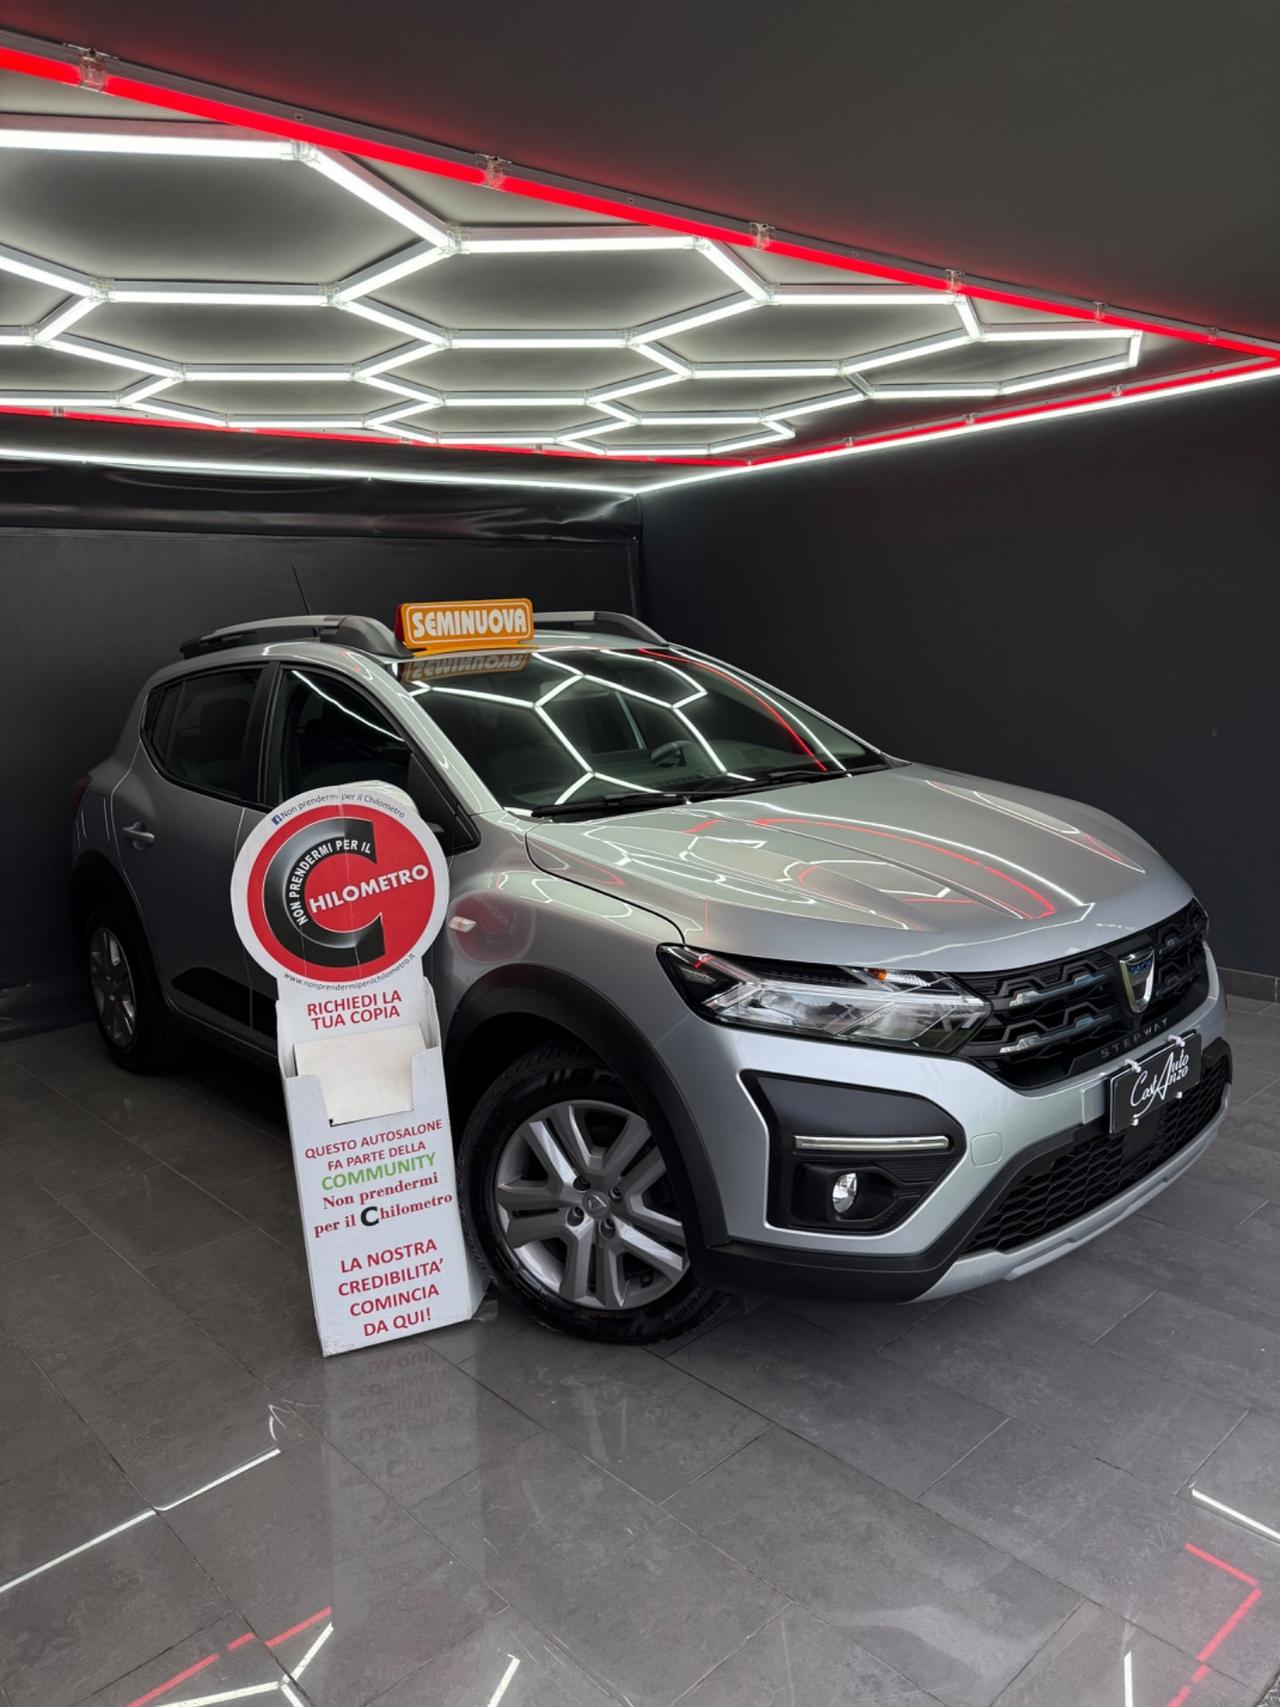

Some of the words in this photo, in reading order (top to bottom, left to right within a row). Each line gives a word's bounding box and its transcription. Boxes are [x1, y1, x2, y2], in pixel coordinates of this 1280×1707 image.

[412, 608, 527, 638] SEMINUOVA
[281, 806, 298, 819] Non
[341, 793, 356, 801] per
[364, 794, 405, 818] Chilometro
[335, 839, 358, 851] PER
[361, 841, 371, 854] IL
[289, 842, 333, 898] PRENDERMI
[289, 901, 309, 926] NON
[307, 993, 377, 1017] RICHIEDI
[382, 990, 402, 1004] LA
[311, 1014, 346, 1031] TUA
[350, 1005, 400, 1024] COPIA
[1101, 1017, 1169, 1058] STEPWAY
[305, 1139, 357, 1159] QUESTO
[360, 1119, 443, 1148] AUTOSALONE
[321, 1151, 436, 1191] COMMUNITY
[327, 1160, 343, 1171] FA
[346, 1149, 385, 1168] PARTE
[389, 1141, 426, 1158] DELLA
[322, 1194, 355, 1210] Non
[359, 1171, 439, 1205] prendermi
[314, 1220, 341, 1239] per
[345, 1213, 356, 1228] il
[340, 1257, 362, 1273] LA
[367, 1238, 438, 1267] NOSTRA
[338, 1257, 444, 1297] CREDIBILITA'
[349, 1283, 440, 1317] COMINCIA
[364, 1319, 389, 1337] DA
[393, 1307, 432, 1329] QUI!
